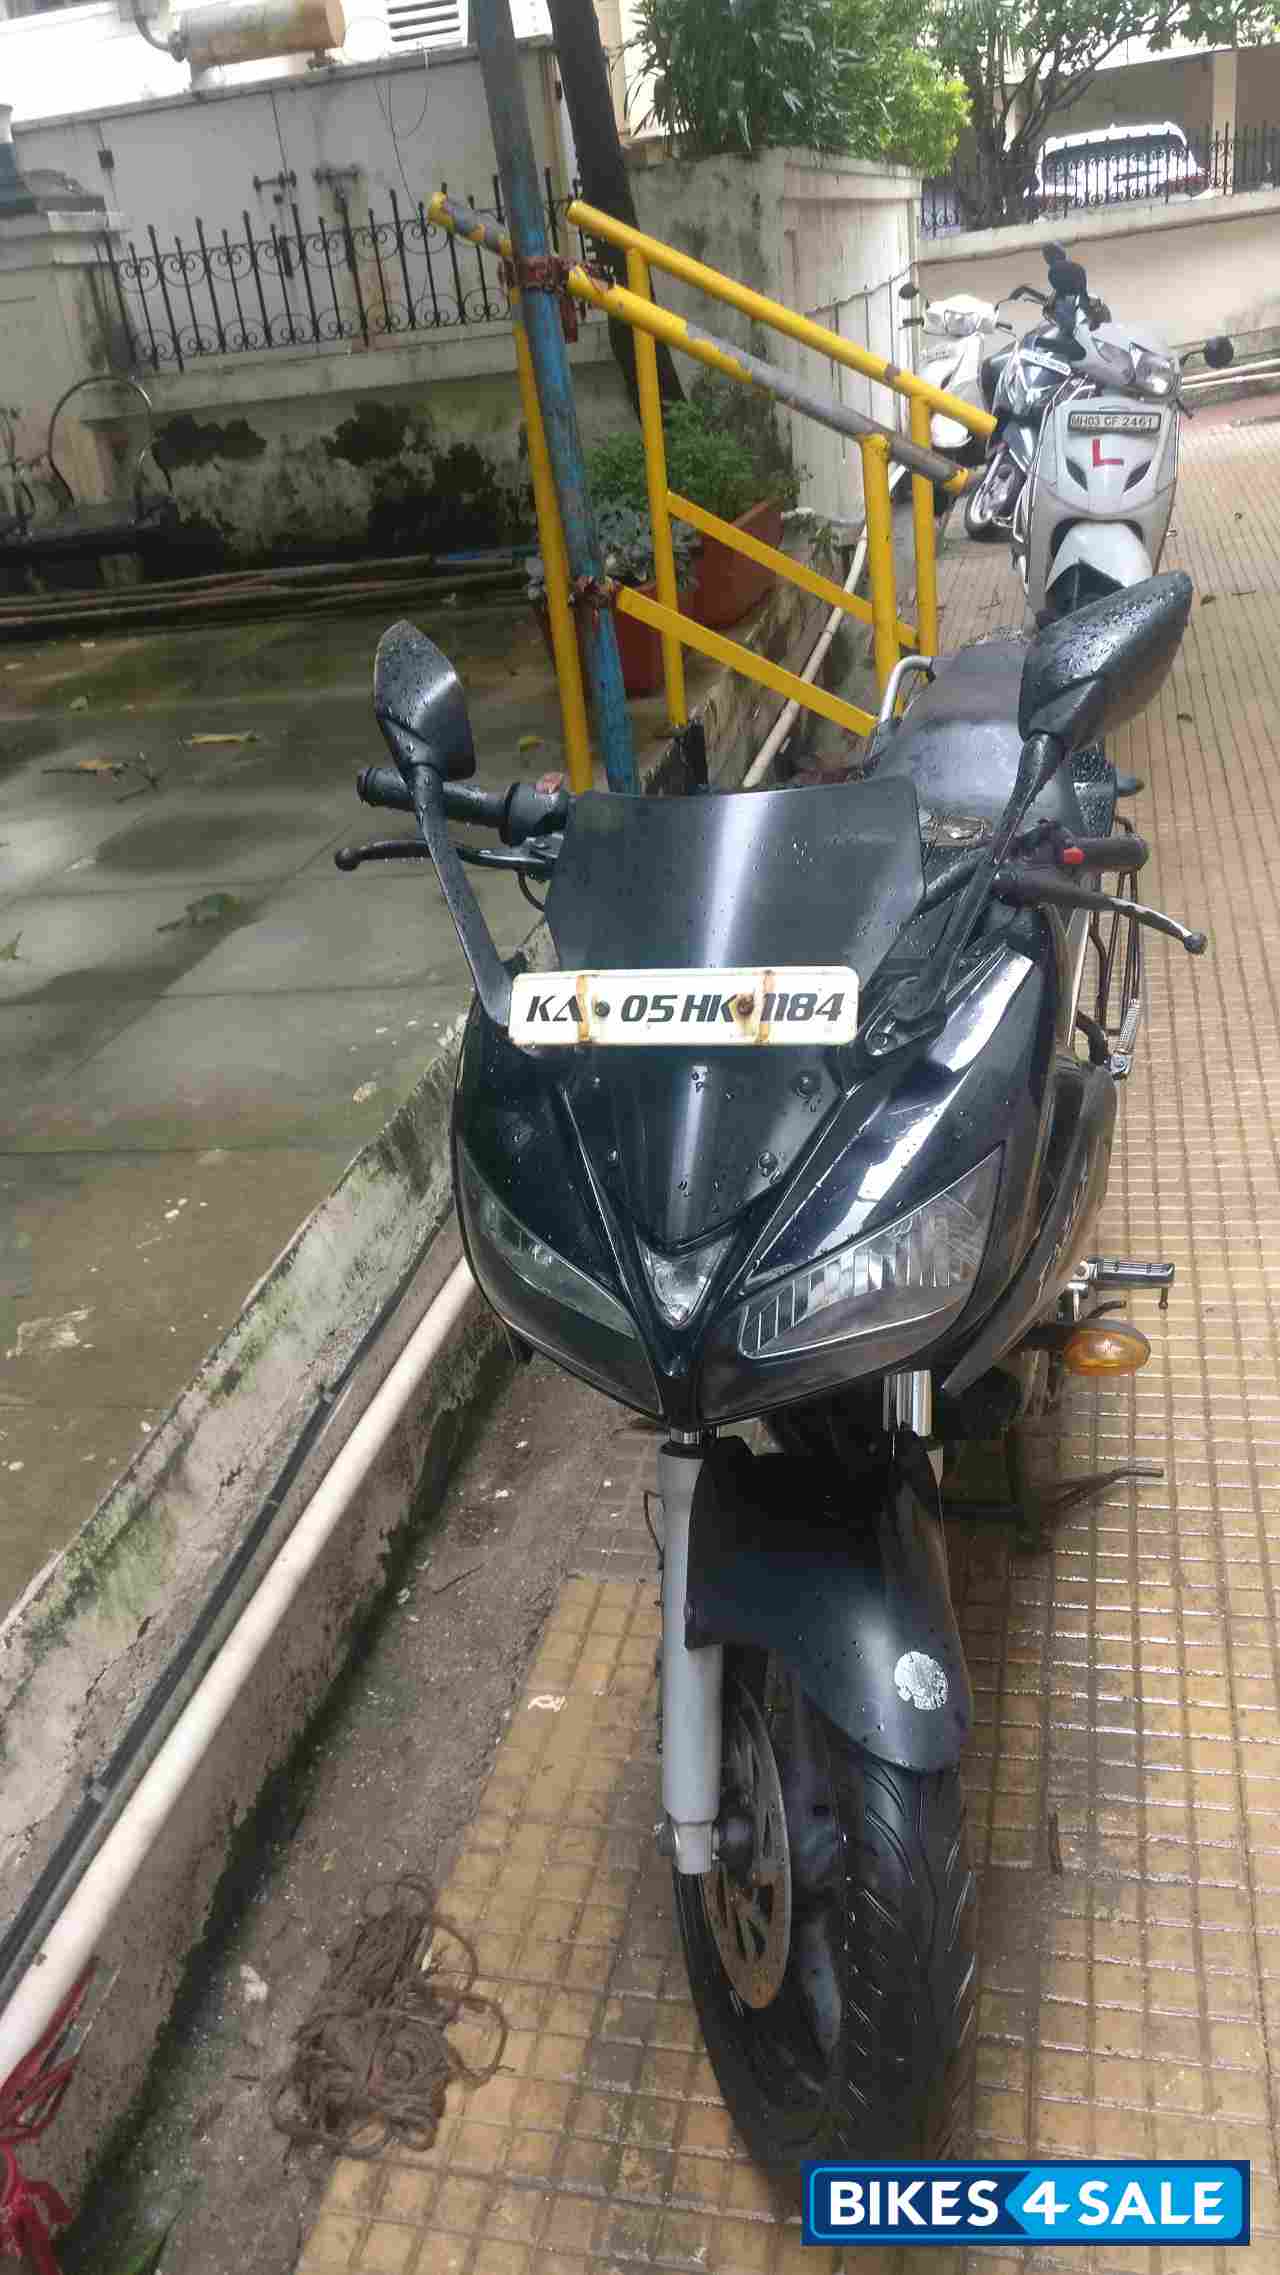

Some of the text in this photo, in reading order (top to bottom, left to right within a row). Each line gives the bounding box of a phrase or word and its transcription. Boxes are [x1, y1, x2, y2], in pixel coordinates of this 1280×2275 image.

[1092, 438, 1124, 468] L
[525, 994, 584, 1023] KA
[760, 992, 845, 1022] 1184
